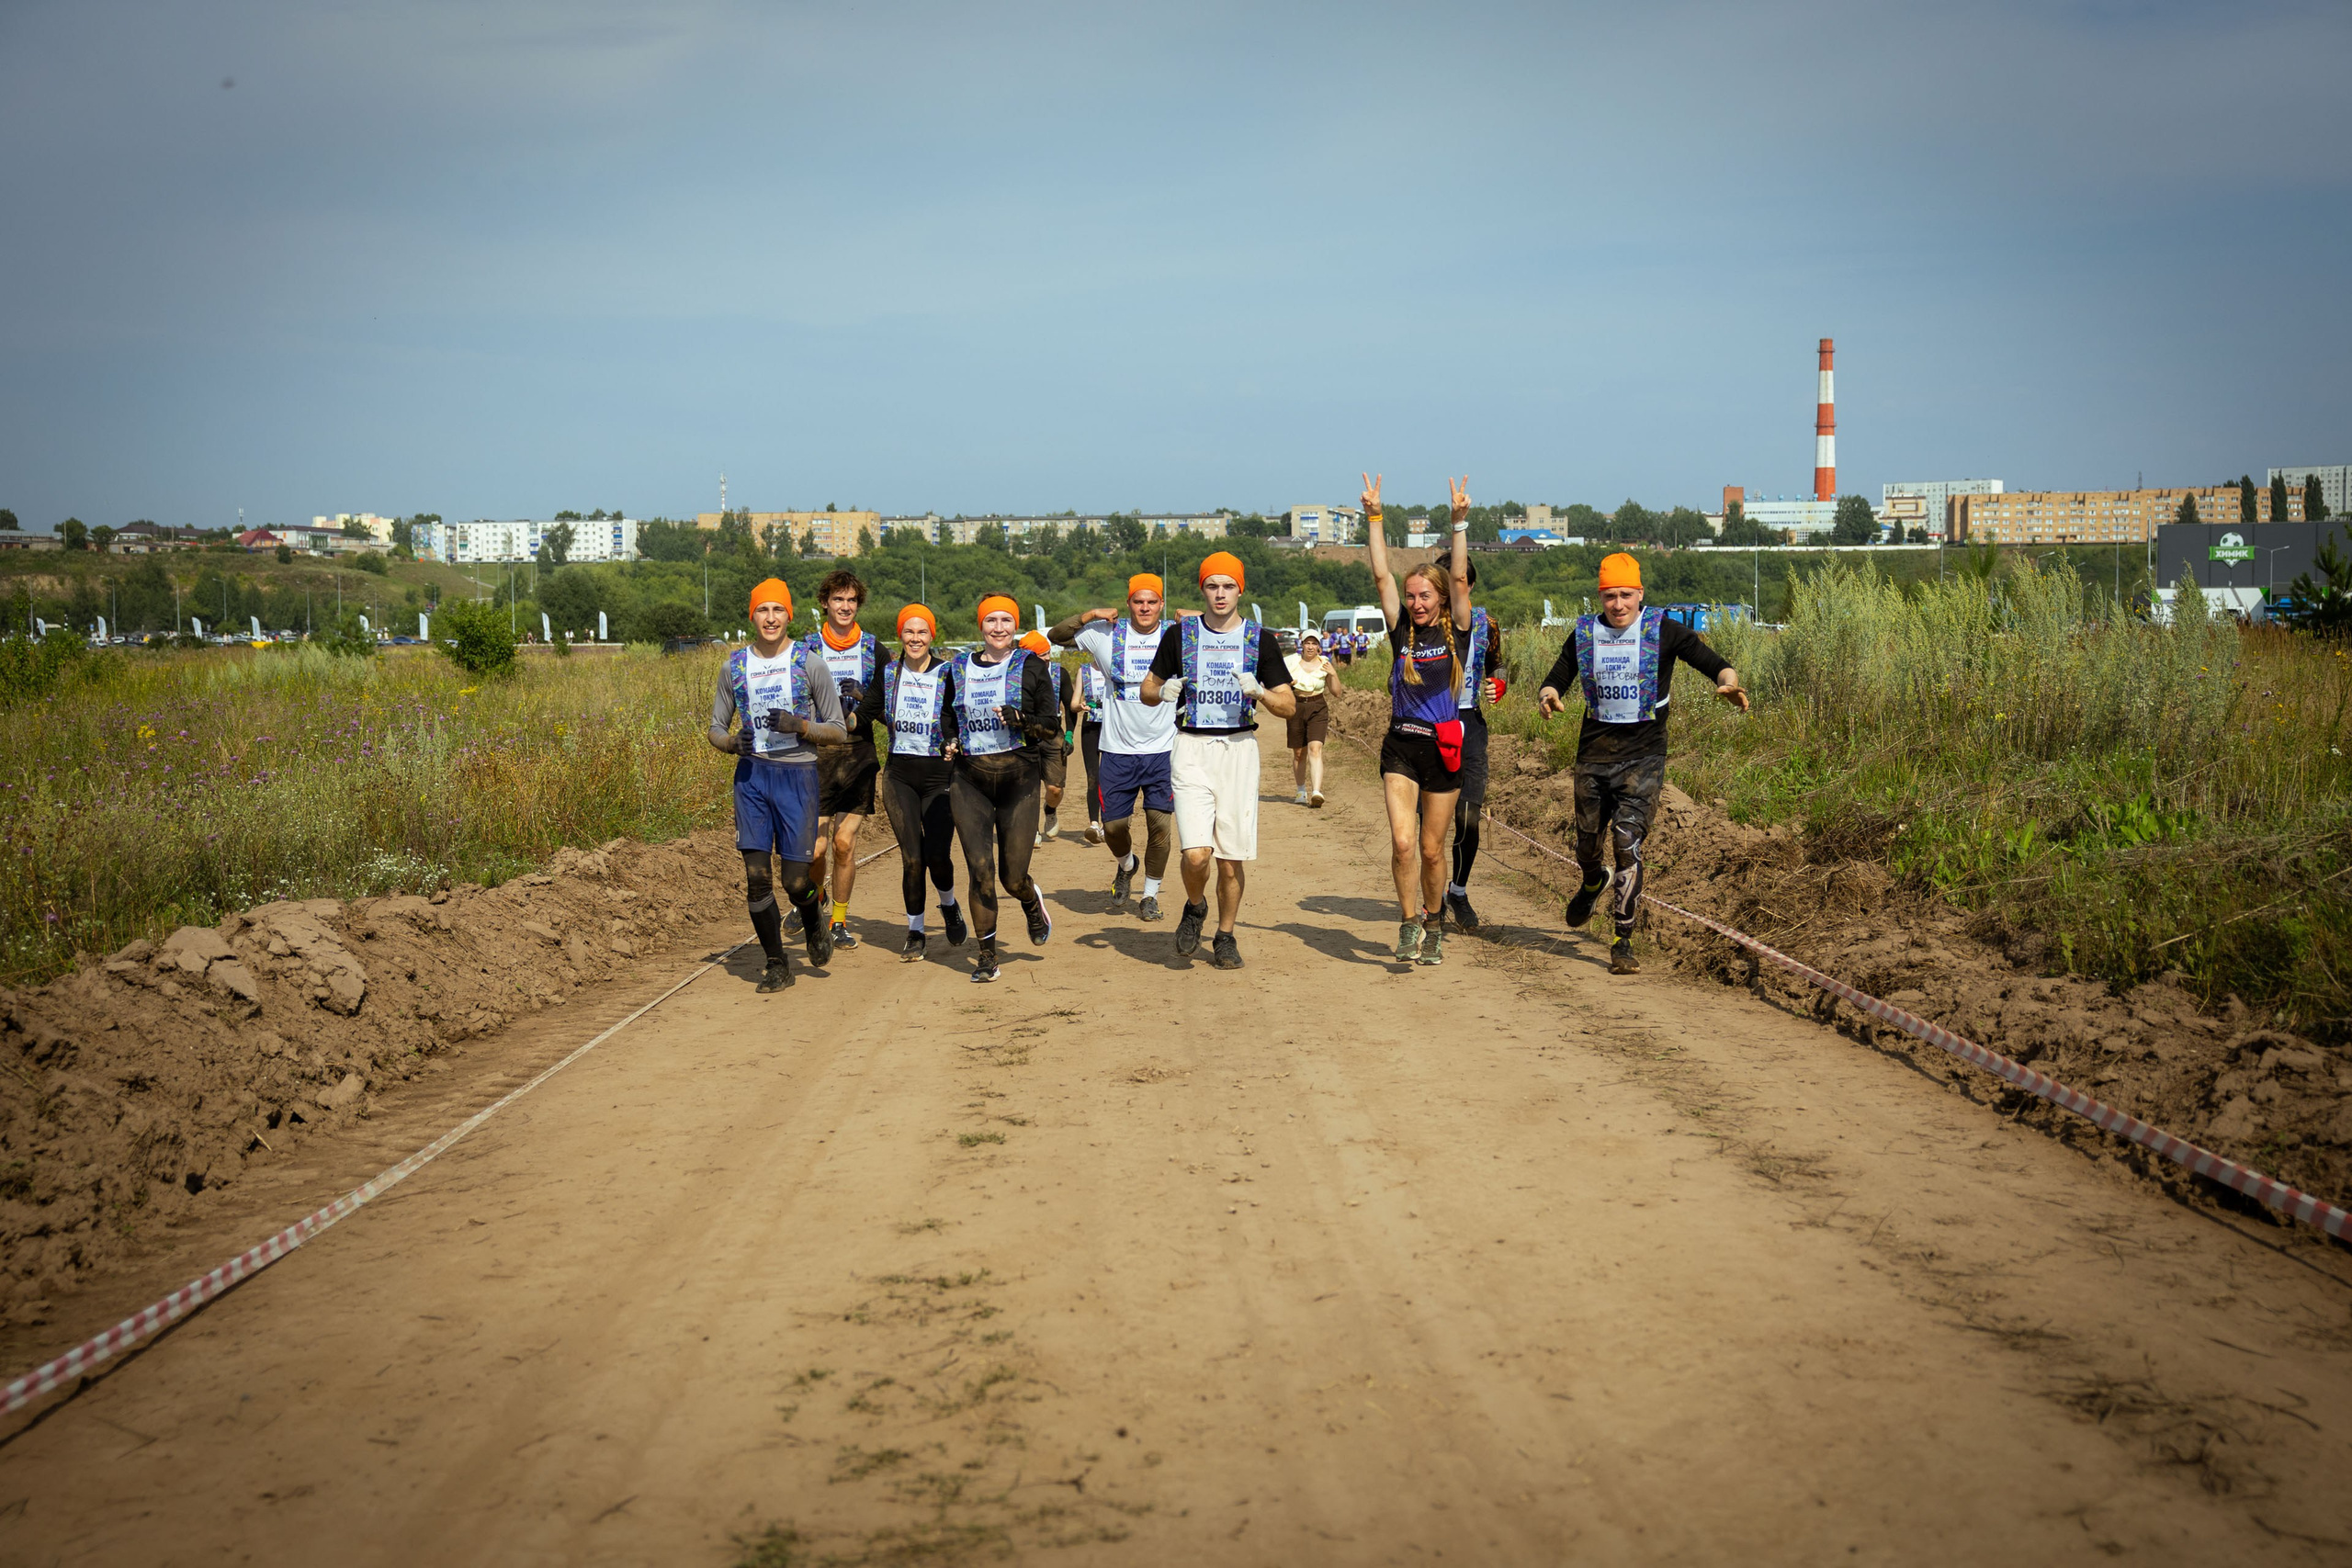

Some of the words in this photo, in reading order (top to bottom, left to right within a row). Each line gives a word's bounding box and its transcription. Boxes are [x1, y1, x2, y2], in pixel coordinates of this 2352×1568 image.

[1202, 675, 1235, 687] РОМА
[755, 684, 783, 694] КОМАНДА
[971, 690, 997, 698] КОМАНДА
[1597, 685, 1638, 700] 03803
[760, 694, 780, 702] 10КМ+
[904, 695, 927, 704] КОМАНДА
[1198, 690, 1240, 705] 03804
[898, 708, 921, 719] ОЛЯ
[895, 719, 930, 736] 03801
